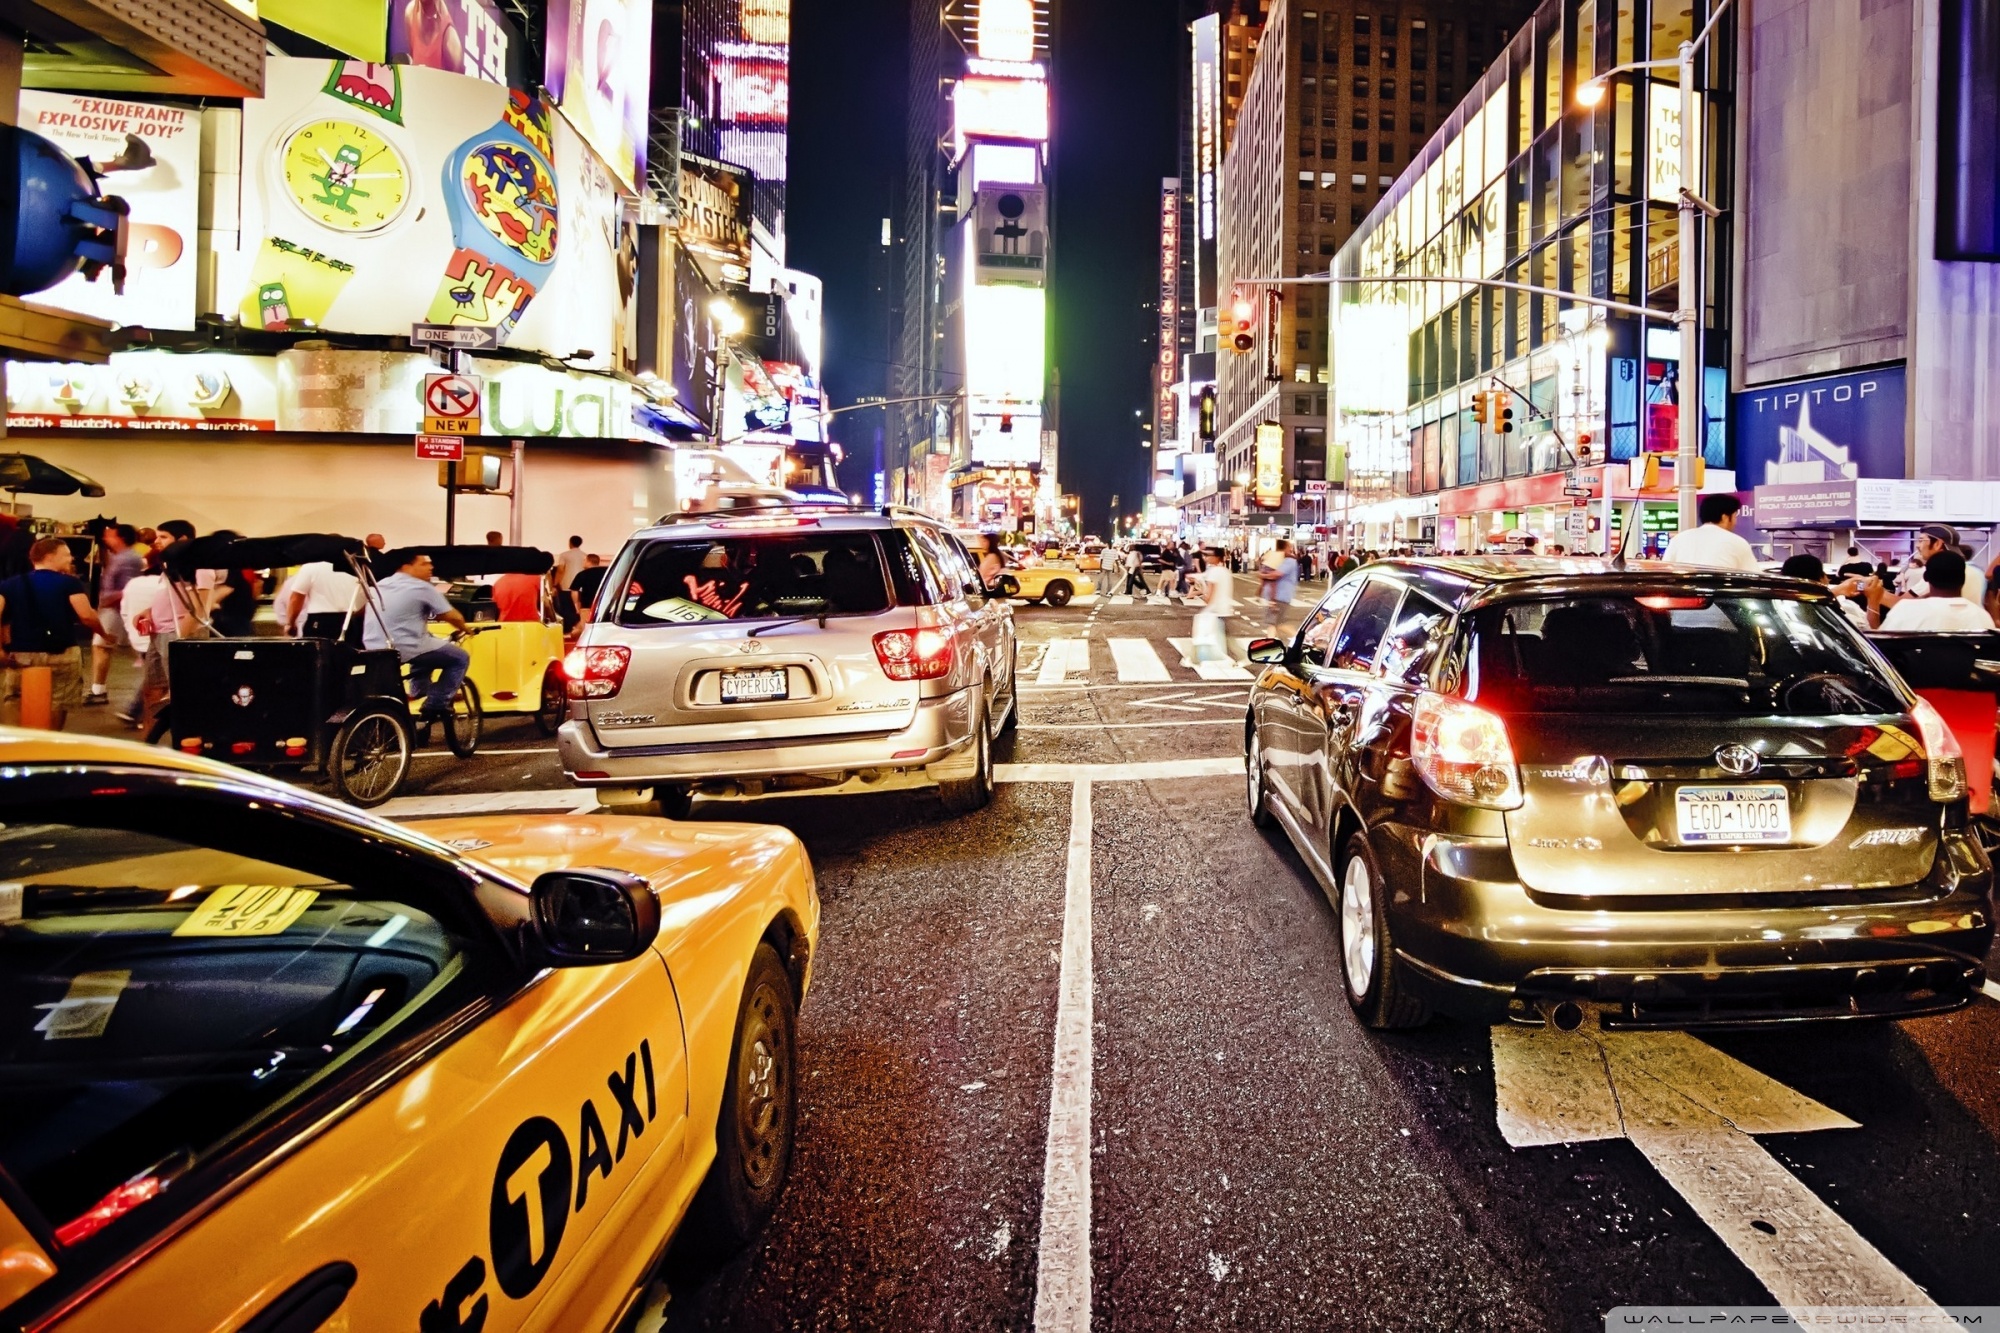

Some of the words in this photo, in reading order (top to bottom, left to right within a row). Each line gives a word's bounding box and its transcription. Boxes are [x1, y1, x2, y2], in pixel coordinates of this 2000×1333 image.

[38, 111, 129, 133] EXPLOSIVE
[1662, 108, 1681, 124] TH
[52, 129, 64, 137] The
[66, 130, 81, 139] New
[83, 132, 99, 141] York
[101, 134, 121, 143] Times
[1656, 127, 1681, 153] LIO
[1655, 158, 1681, 183] KIN
[1437, 165, 1461, 214] THE
[1161, 196, 1175, 282] ERNST
[1452, 191, 1497, 272] KING
[1161, 299, 1174, 313] &
[425, 330, 448, 340] ONE
[460, 333, 484, 341] WAY
[1160, 332, 1174, 421] YOUNG
[1755, 393, 1799, 412] TIP
[1812, 382, 1877, 405] TOP
[435, 420, 468, 431] NEW
[430, 437, 460, 445] STANDING
[1787, 491, 1851, 501] AVAILABILITIES
[726, 678, 783, 695] CYPERUSA
[1703, 790, 1728, 801] NEW
[1731, 790, 1761, 801] YORK
[1720, 832, 1743, 840] EMPIRE
